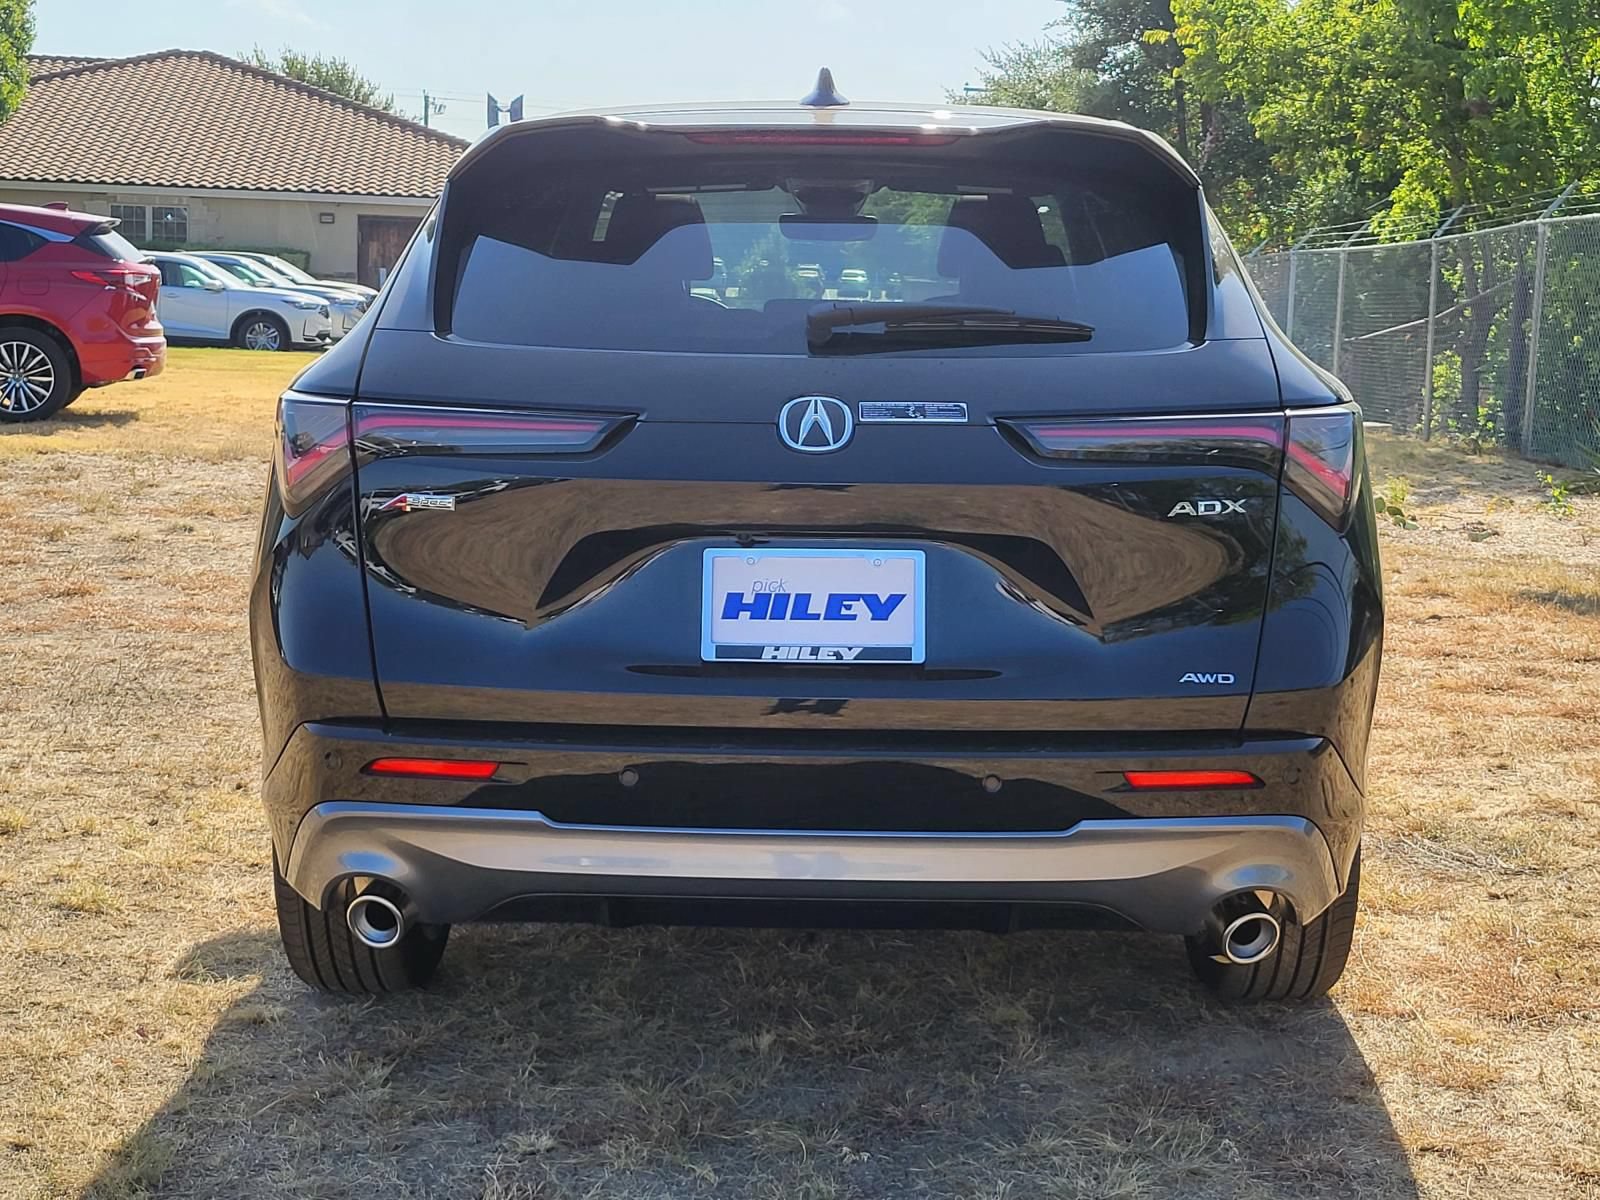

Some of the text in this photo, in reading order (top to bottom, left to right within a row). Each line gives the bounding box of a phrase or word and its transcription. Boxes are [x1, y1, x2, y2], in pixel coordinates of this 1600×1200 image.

[1168, 499, 1246, 517] ADX
[751, 578, 787, 593] pick
[721, 592, 907, 621] HILEY
[761, 646, 863, 660] HILEY
[1179, 673, 1235, 684] AWD
